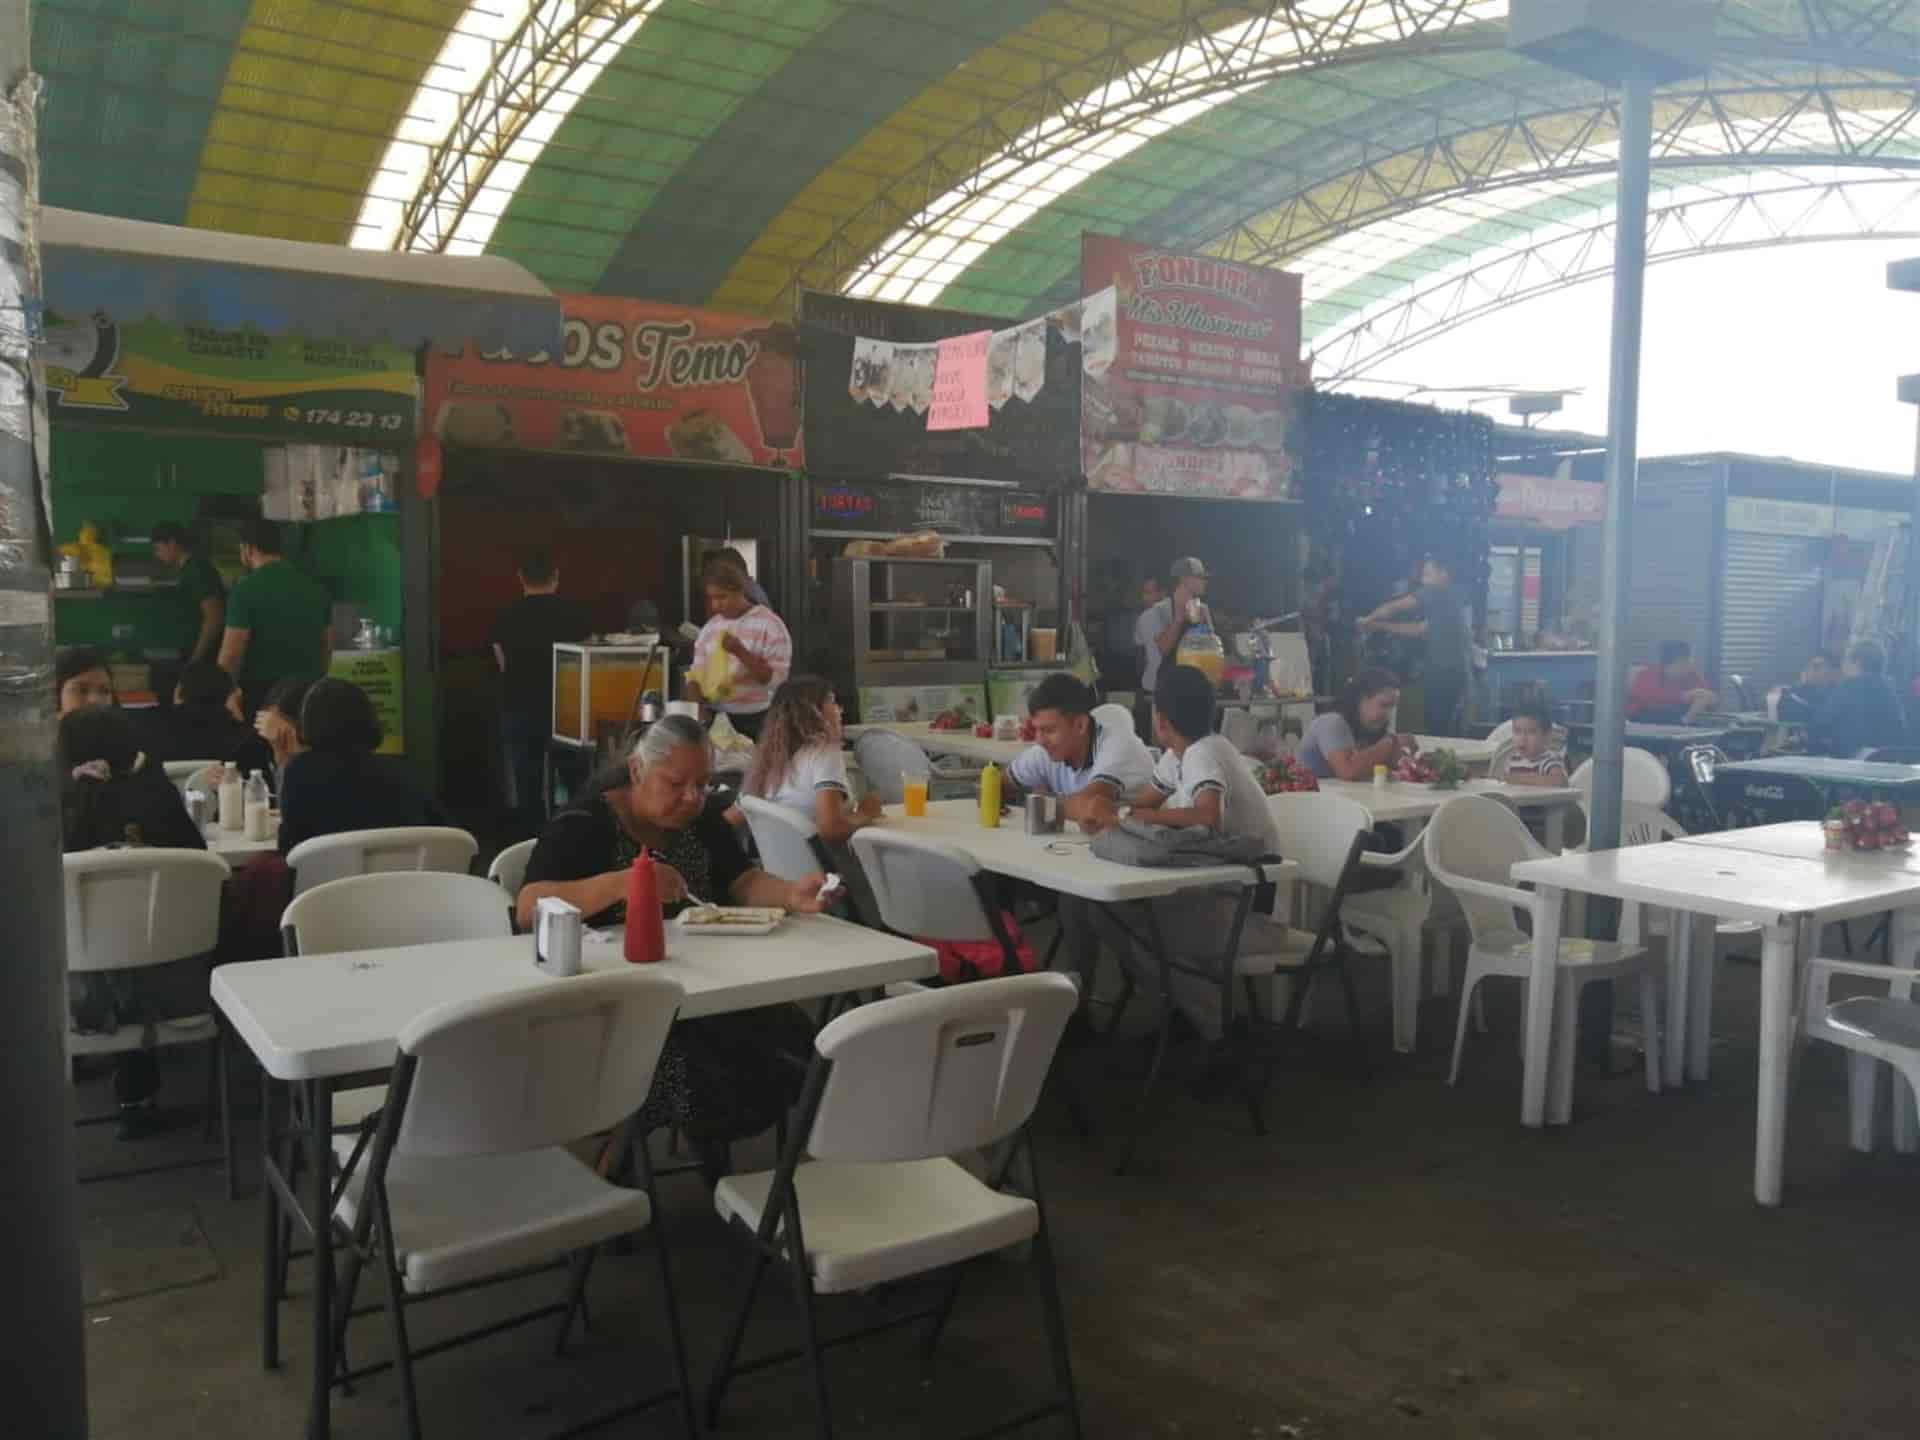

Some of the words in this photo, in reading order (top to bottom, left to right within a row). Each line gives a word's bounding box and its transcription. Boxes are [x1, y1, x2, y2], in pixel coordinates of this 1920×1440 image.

[635, 319, 759, 391] Temo
[305, 408, 341, 426] 174
[344, 411, 374, 428] 23
[379, 413, 404, 430] 13
